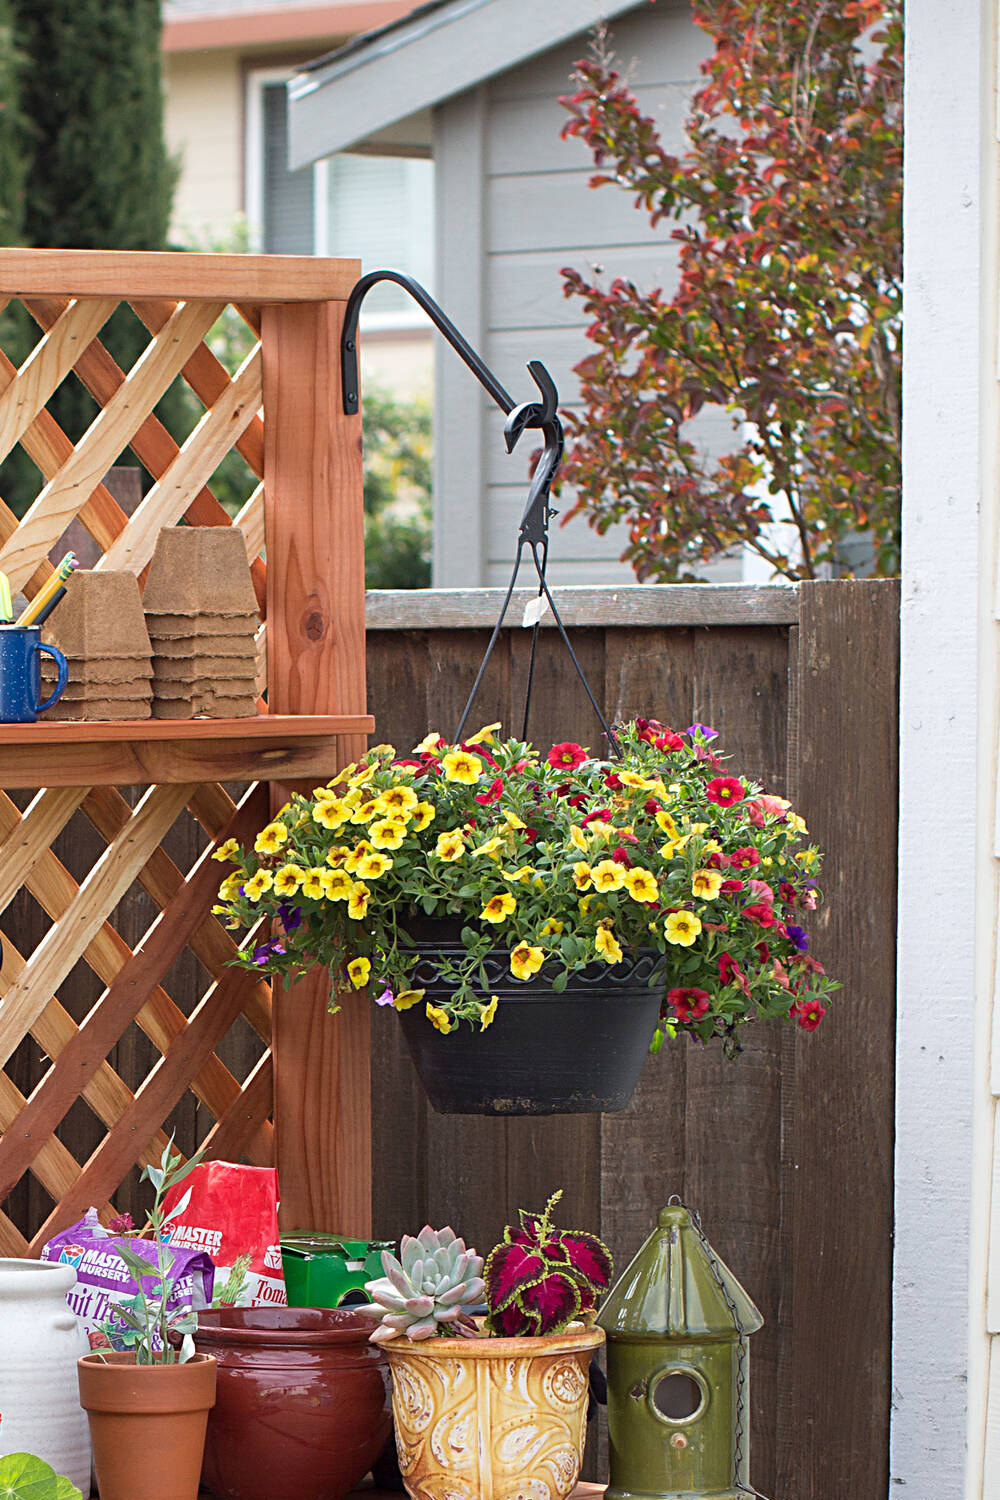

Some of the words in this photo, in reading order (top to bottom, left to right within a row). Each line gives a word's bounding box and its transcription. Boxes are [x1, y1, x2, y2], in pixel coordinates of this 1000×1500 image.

[173, 1225, 223, 1246] MASTER
[82, 1249, 131, 1274] MASTE
[78, 1264, 131, 1283] NURSERY
